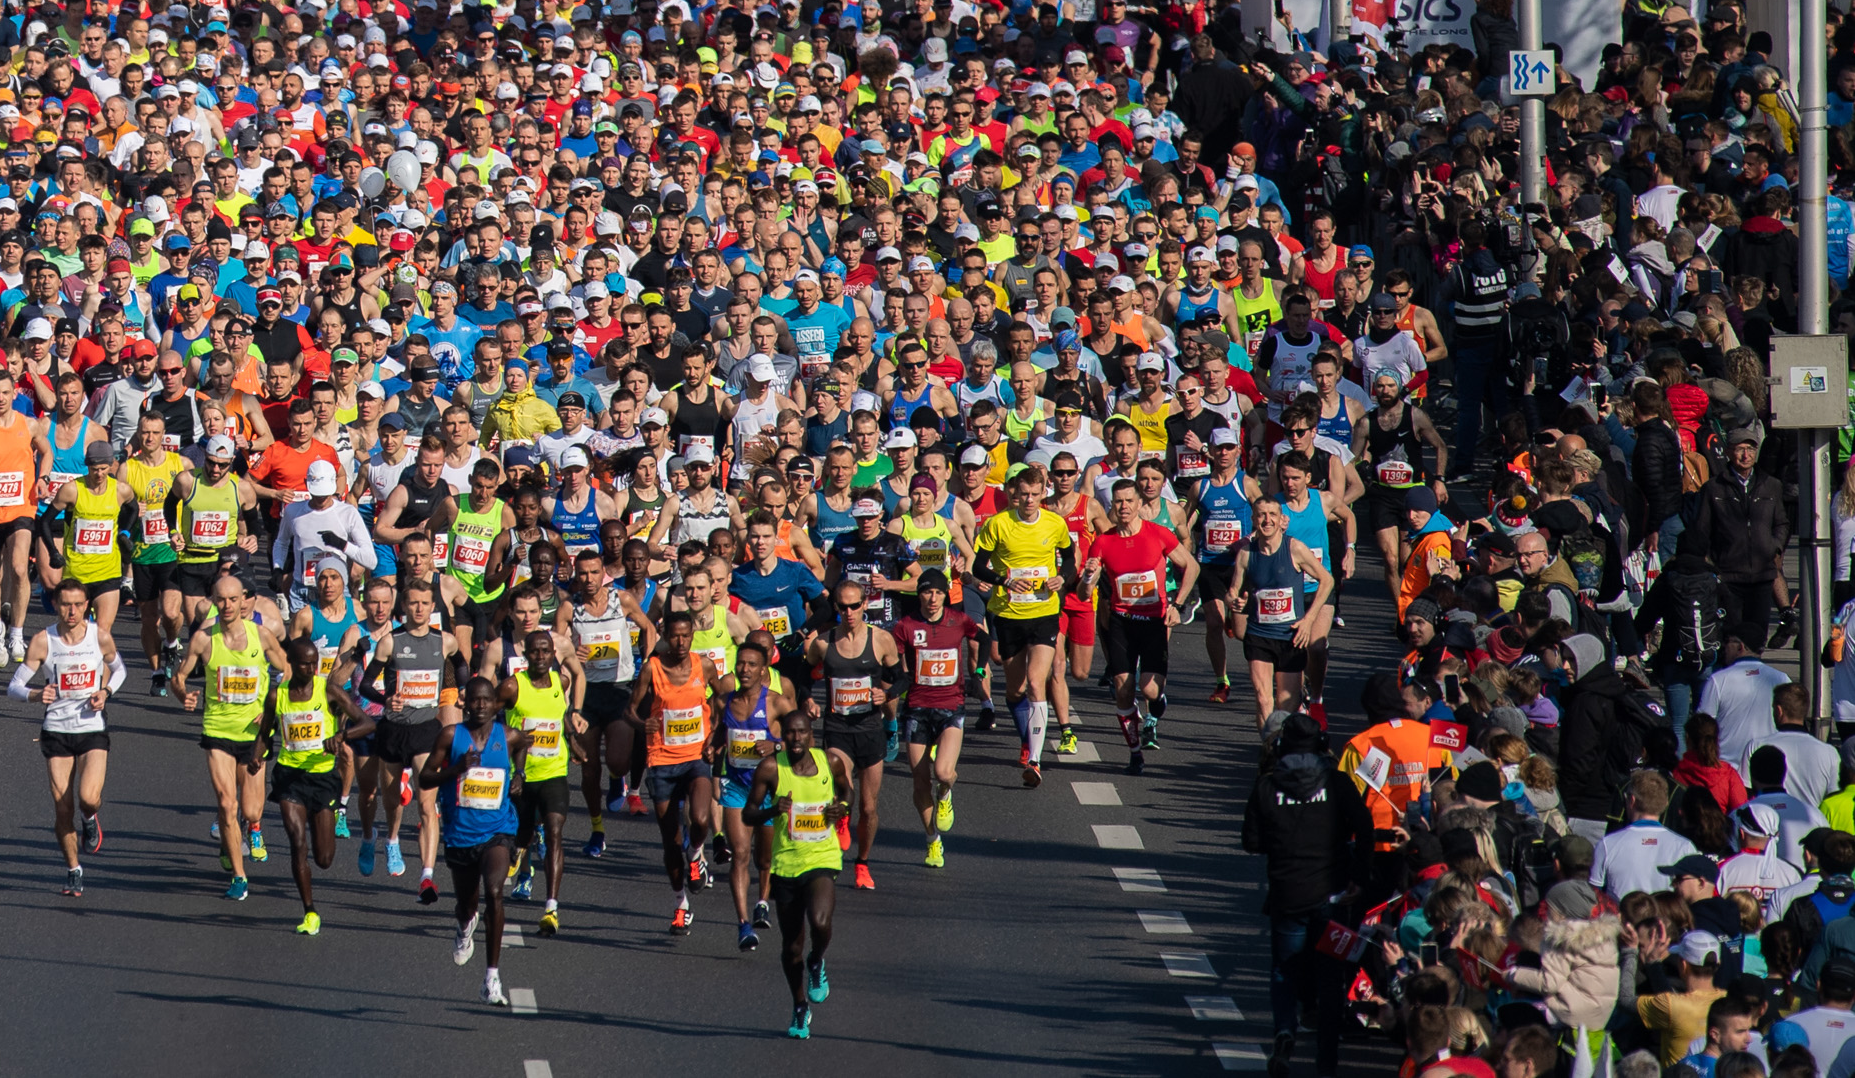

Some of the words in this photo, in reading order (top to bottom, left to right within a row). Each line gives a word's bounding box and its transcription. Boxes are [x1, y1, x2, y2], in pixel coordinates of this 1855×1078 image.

[1431, 28, 1468, 36] LONG
[796, 329, 825, 342] ASSECO
[149, 520, 167, 532] 215
[200, 521, 223, 533] 1062
[83, 530, 107, 542] 5961
[1212, 531, 1235, 540] 5421
[433, 544, 444, 555] 53
[459, 549, 485, 562] 5060
[919, 553, 944, 562] SOWSKA
[1131, 585, 1144, 596] 61
[1265, 600, 1287, 611] 5389
[780, 619, 787, 630] 3
[595, 645, 609, 658] 37
[930, 663, 945, 675] 62
[66, 673, 92, 686] 3804
[289, 726, 313, 740] PACE
[314, 724, 320, 737] 2
[668, 721, 700, 733] TSEGAY
[1435, 737, 1458, 746] ORLEN
[462, 782, 500, 795] CHERUIYOT
